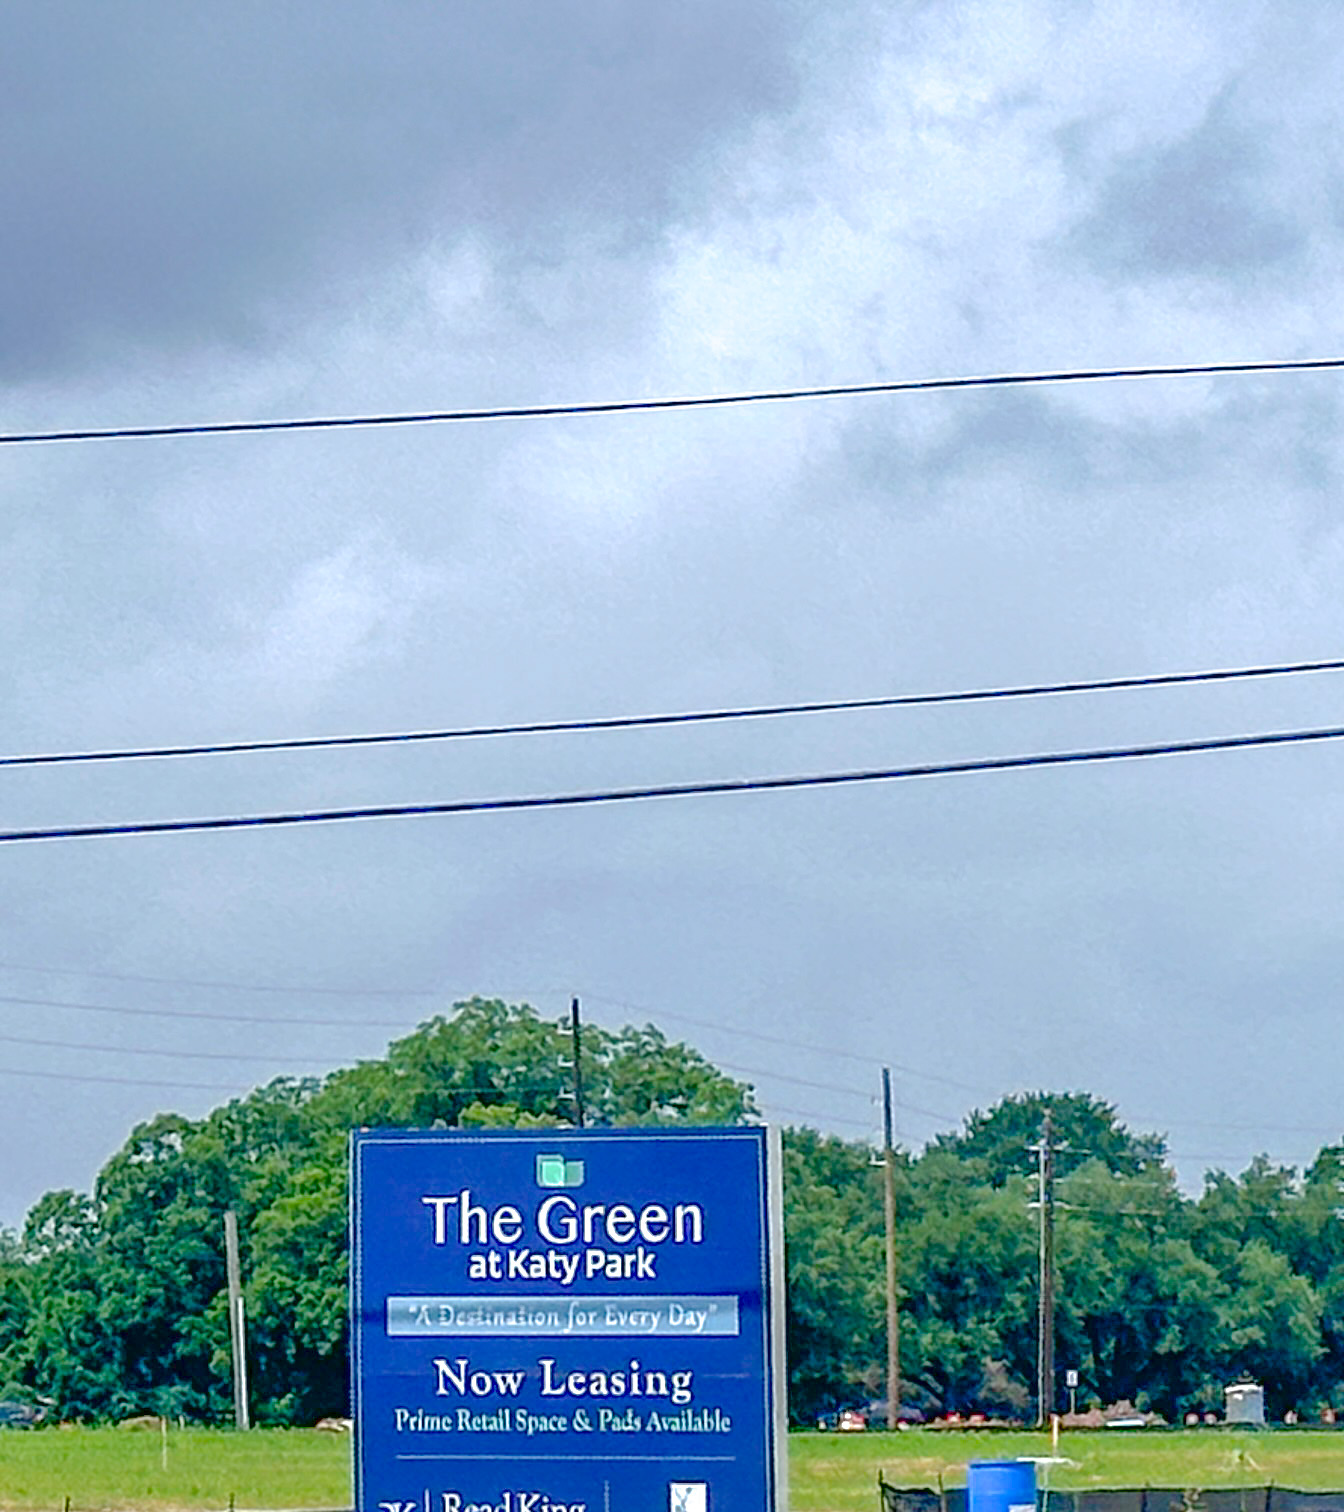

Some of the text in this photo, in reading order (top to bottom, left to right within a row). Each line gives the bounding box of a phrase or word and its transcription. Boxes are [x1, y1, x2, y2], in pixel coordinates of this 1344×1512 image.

[421, 1190, 702, 1244] The Green
[469, 1246, 656, 1285] at Katy Park
[439, 1304, 559, 1326] Destination
[563, 1301, 597, 1333] for
[605, 1304, 662, 1333] Every
[433, 1359, 694, 1404] Now Leasing
[395, 1408, 732, 1436] Prime Retail Space & Pads Available
